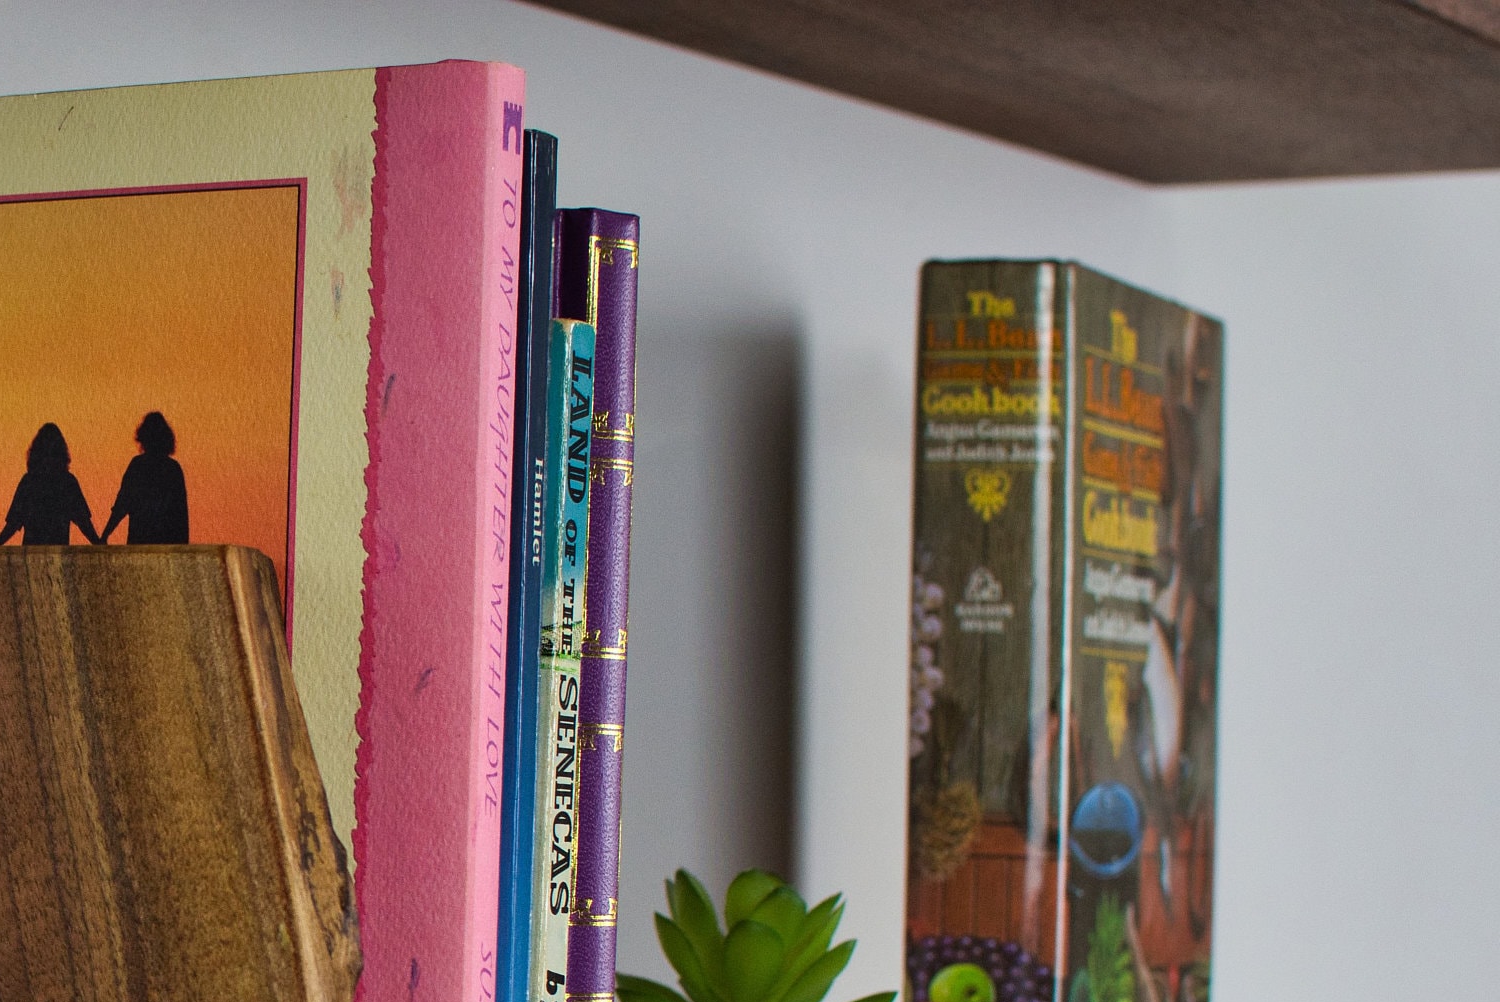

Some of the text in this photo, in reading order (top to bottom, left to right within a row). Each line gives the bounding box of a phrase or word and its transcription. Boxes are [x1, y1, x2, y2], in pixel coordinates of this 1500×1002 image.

[502, 178, 517, 229] TO
[500, 245, 515, 310] MY
[967, 291, 1016, 318] The
[490, 322, 512, 563] DAUGHTER
[532, 456, 544, 567] Hamlet
[488, 582, 504, 699] WITH
[550, 350, 593, 916] LAND OF THE SENECAS
[484, 716, 500, 817] LOVE
